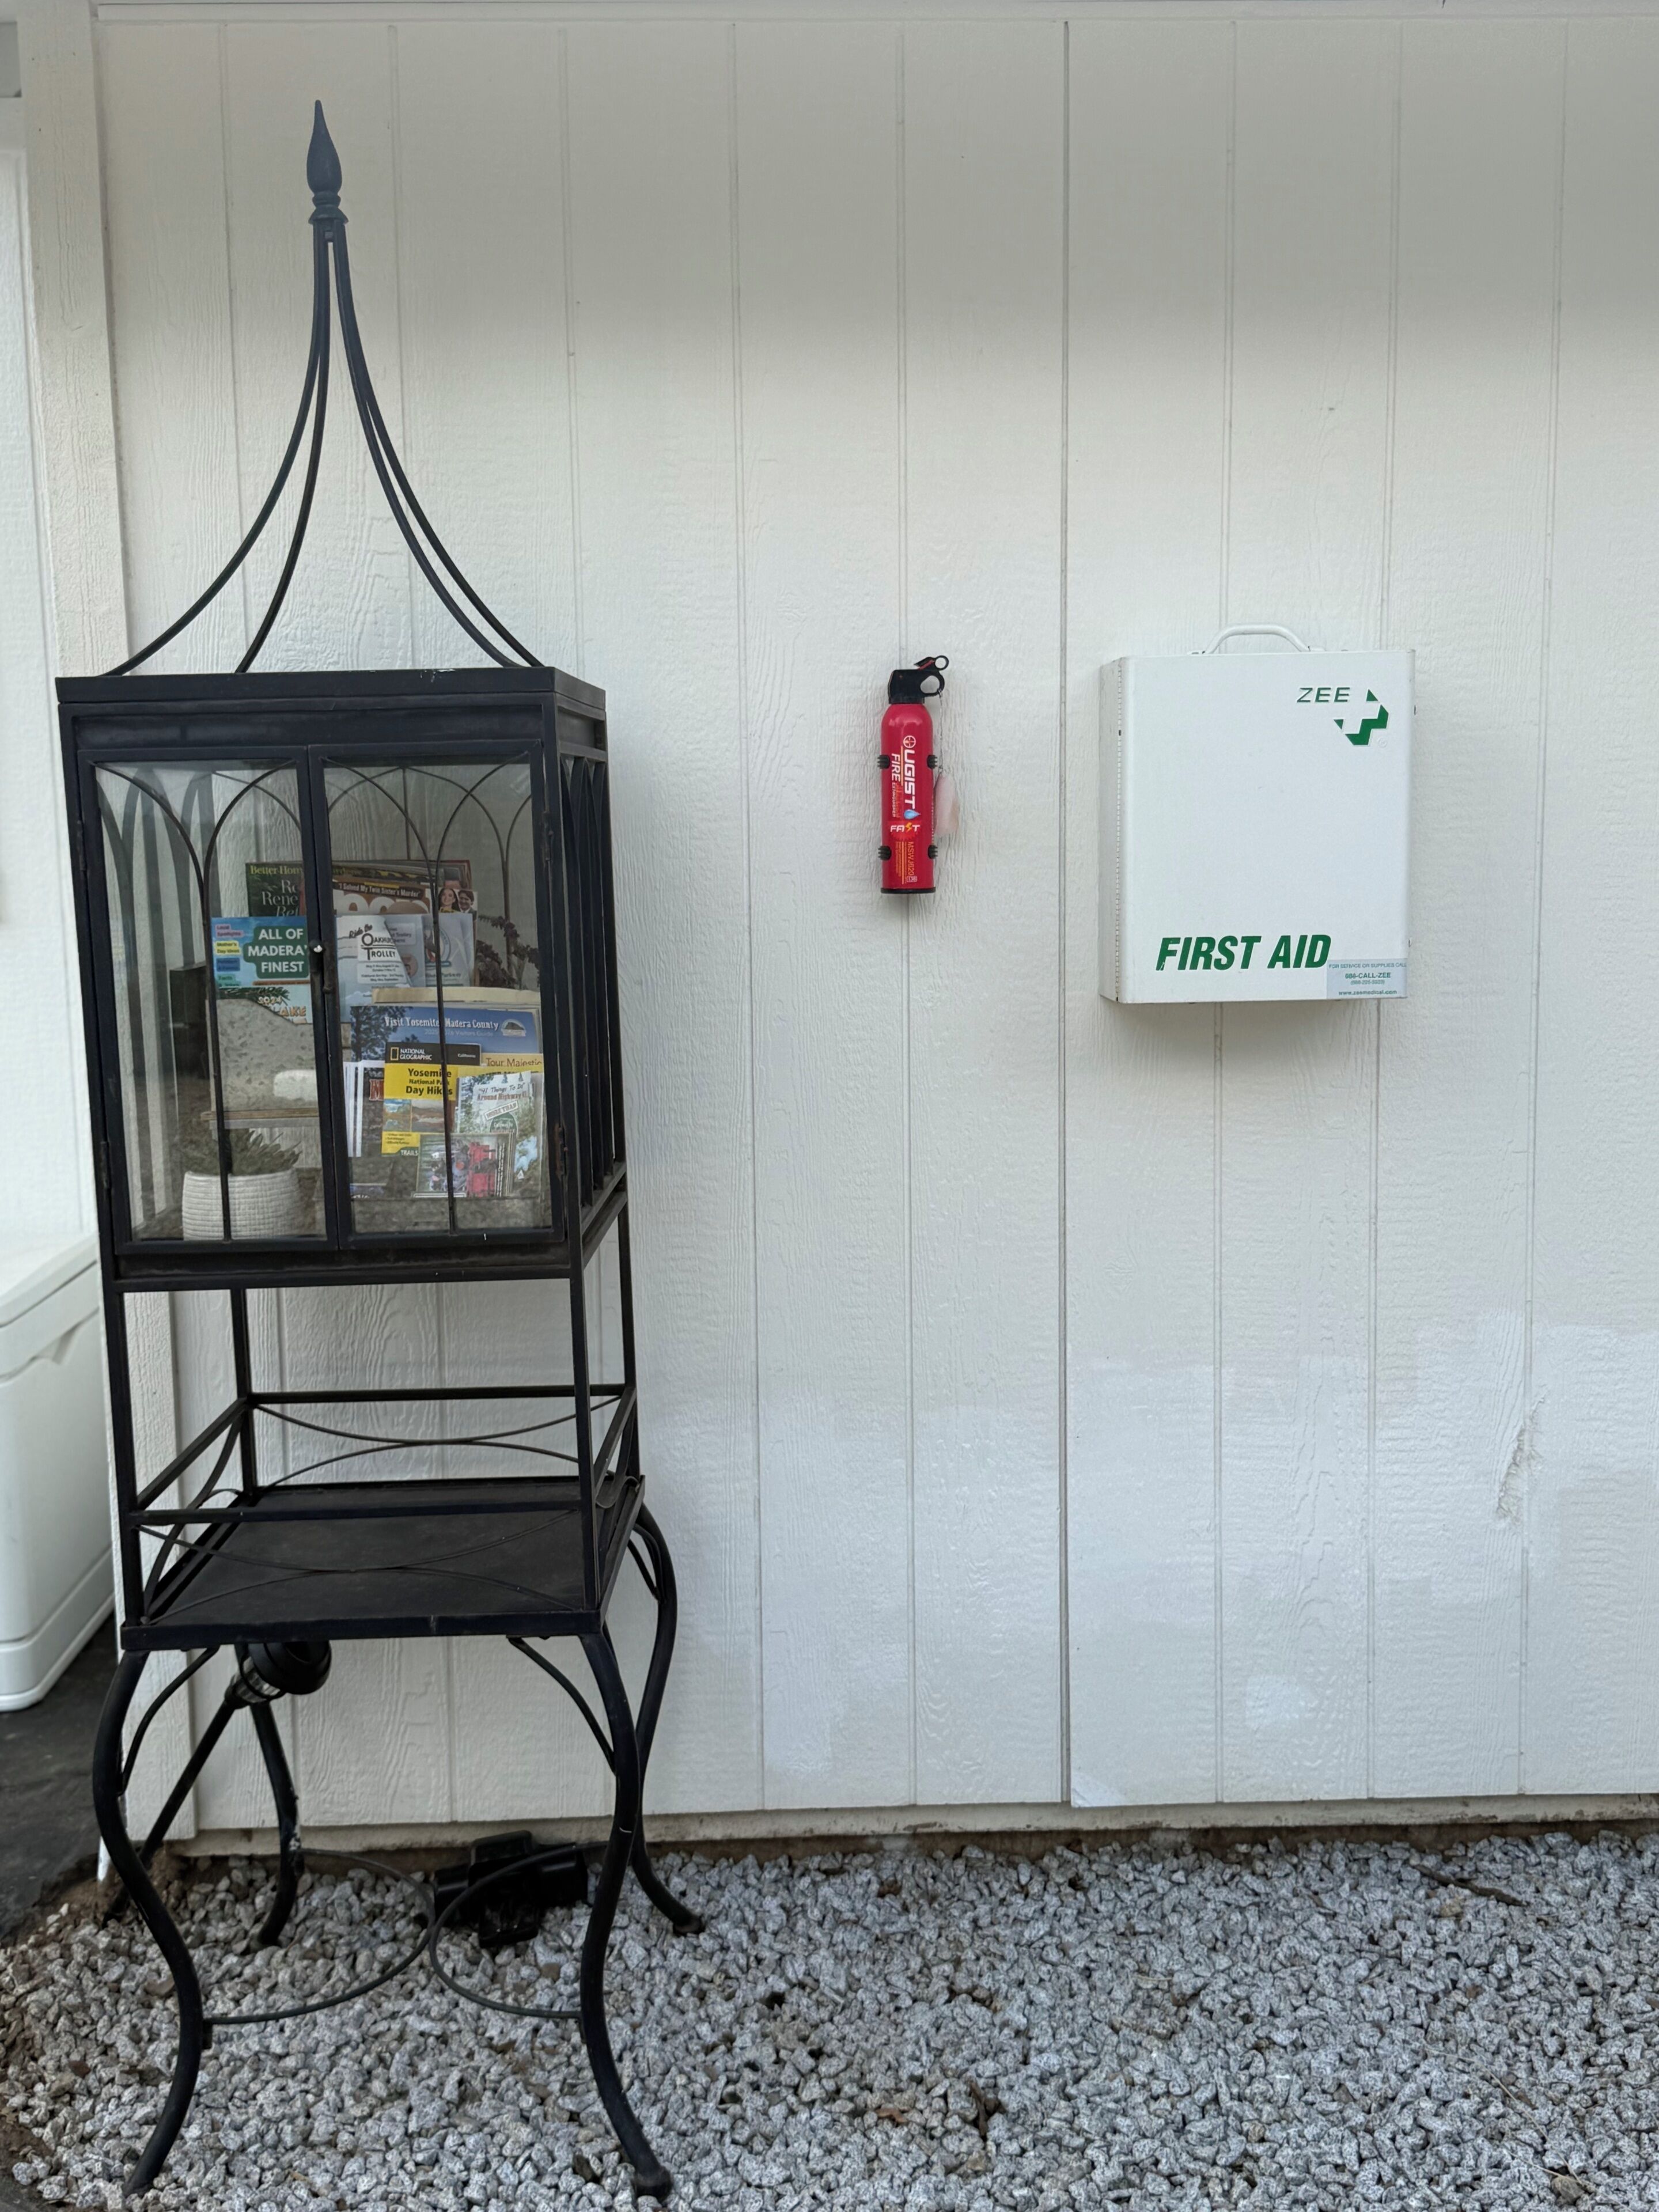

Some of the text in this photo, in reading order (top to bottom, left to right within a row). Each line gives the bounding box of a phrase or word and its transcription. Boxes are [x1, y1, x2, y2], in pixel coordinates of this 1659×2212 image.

[1297, 687, 1350, 702] ZEE
[891, 753, 900, 782] FIRE
[250, 866, 278, 875] Better
[259, 929, 304, 940] ALL OF
[248, 945, 307, 957] MADERA'
[1156, 934, 1331, 971] FIRST AID
[261, 961, 305, 973] FINEST
[385, 1017, 499, 1031] Visit Yosemite Madera County
[486, 1058, 503, 1067] Tour
[408, 1068, 452, 1078] Yosemie
[406, 1086, 453, 1096] Day Hiks
